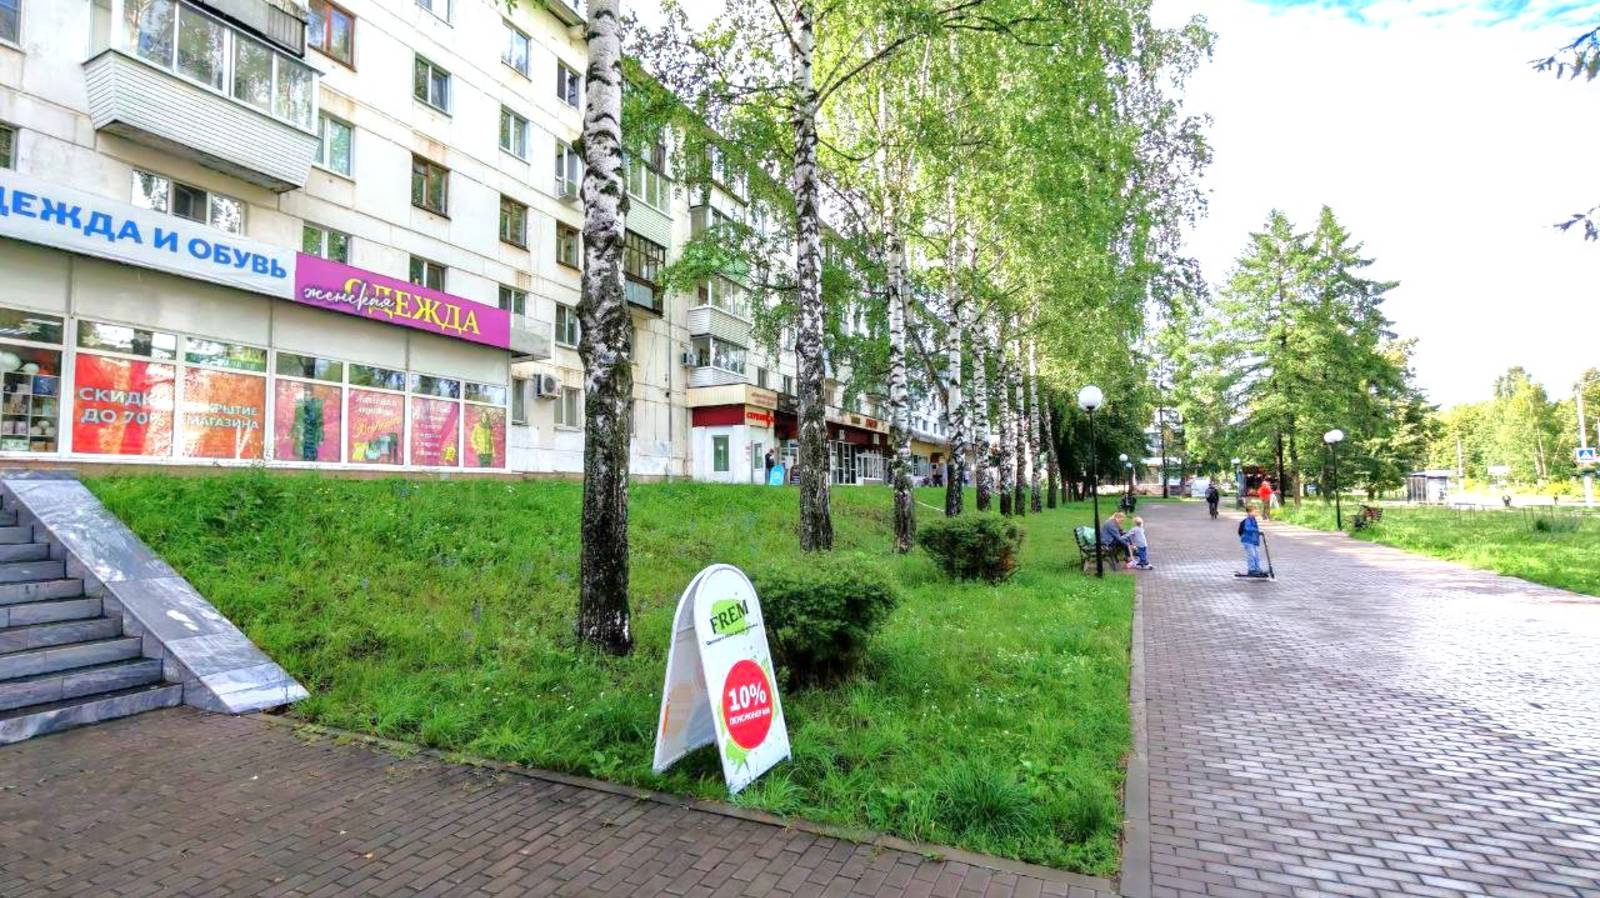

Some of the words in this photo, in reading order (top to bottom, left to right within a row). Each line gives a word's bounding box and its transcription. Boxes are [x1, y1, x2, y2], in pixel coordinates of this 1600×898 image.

[0, 186, 142, 243] ЕЖДА
[154, 227, 178, 253] И
[187, 238, 288, 279] ОБУВЬ
[80, 408, 117, 424] ДО
[123, 411, 164, 427] 70%
[710, 599, 749, 634] FREM
[728, 681, 767, 712] 10%
